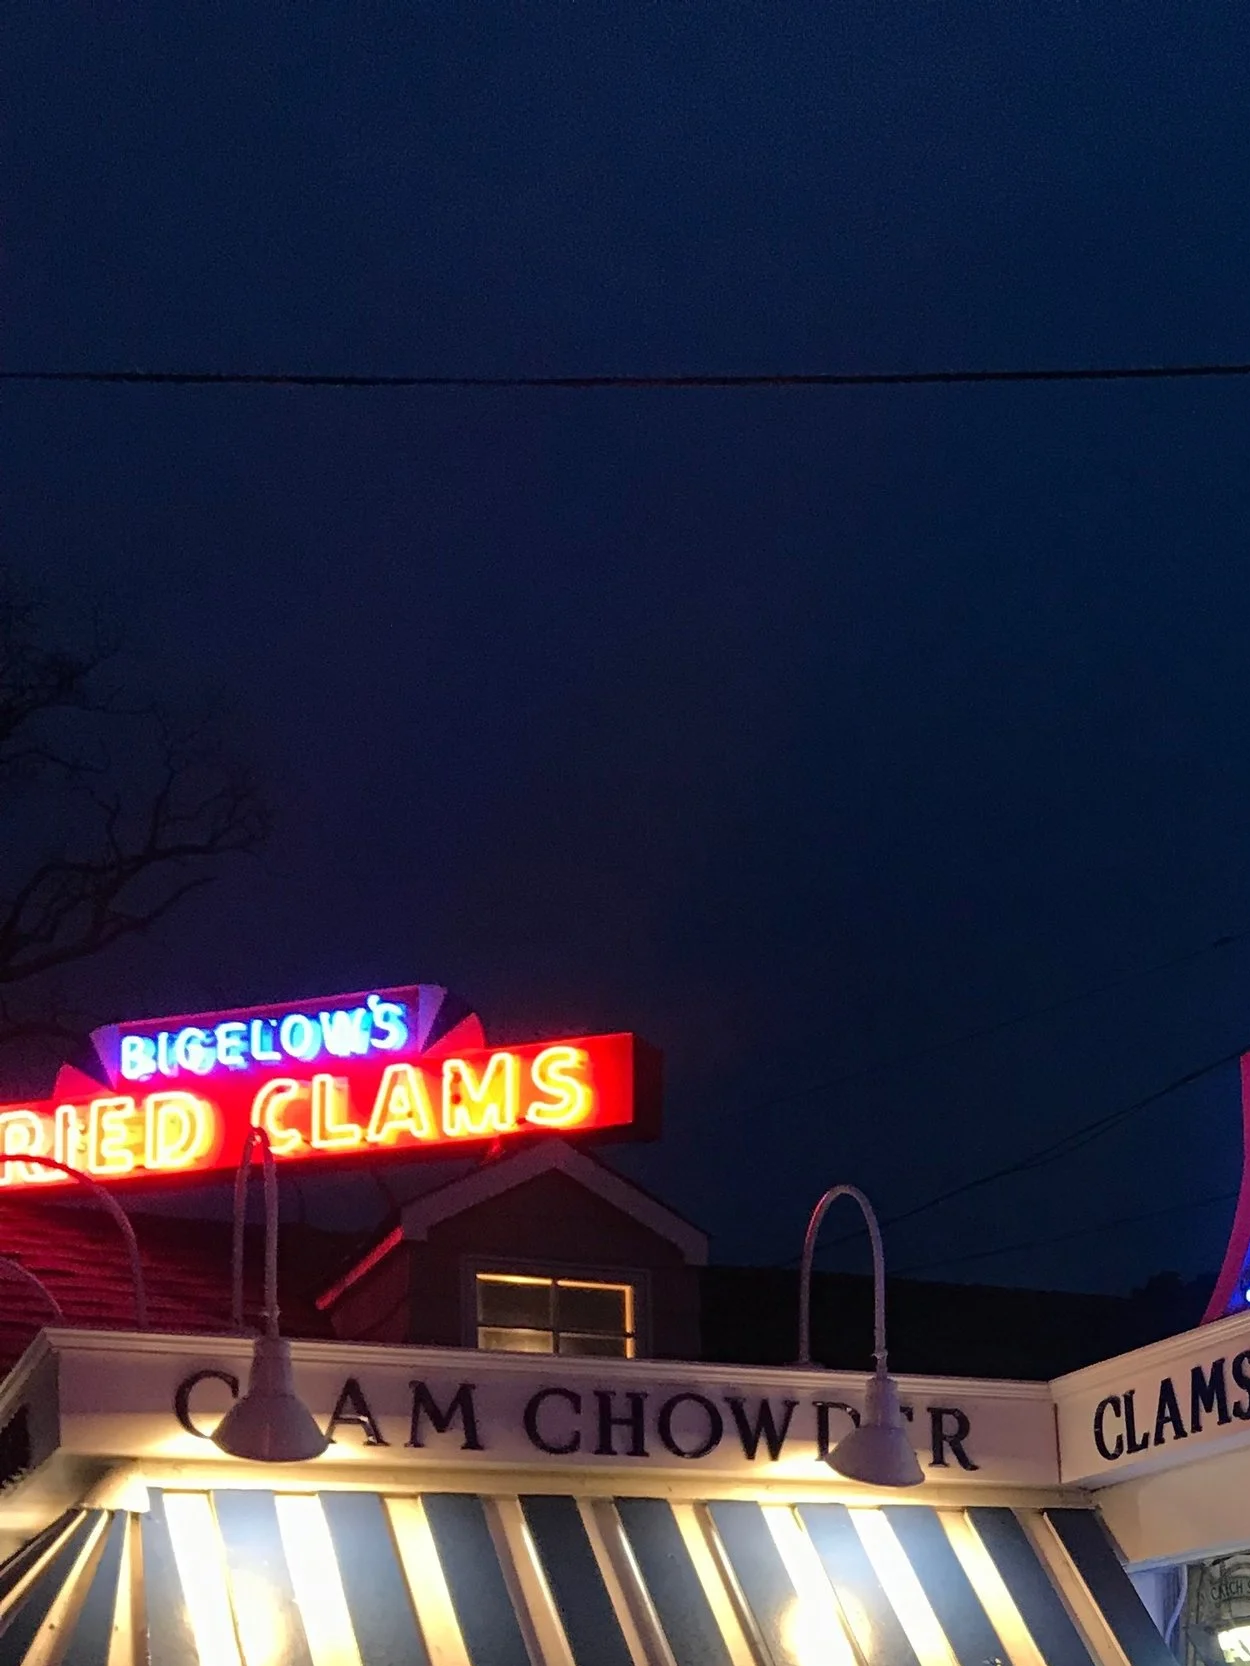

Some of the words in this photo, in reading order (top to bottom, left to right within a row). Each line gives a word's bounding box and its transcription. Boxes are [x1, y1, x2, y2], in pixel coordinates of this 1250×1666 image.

[120, 994, 408, 1081] BIGELOW'S
[250, 1045, 592, 1154] CLAMS
[175, 1370, 484, 1450] CAM
[523, 1387, 979, 1470] CHOWDR
